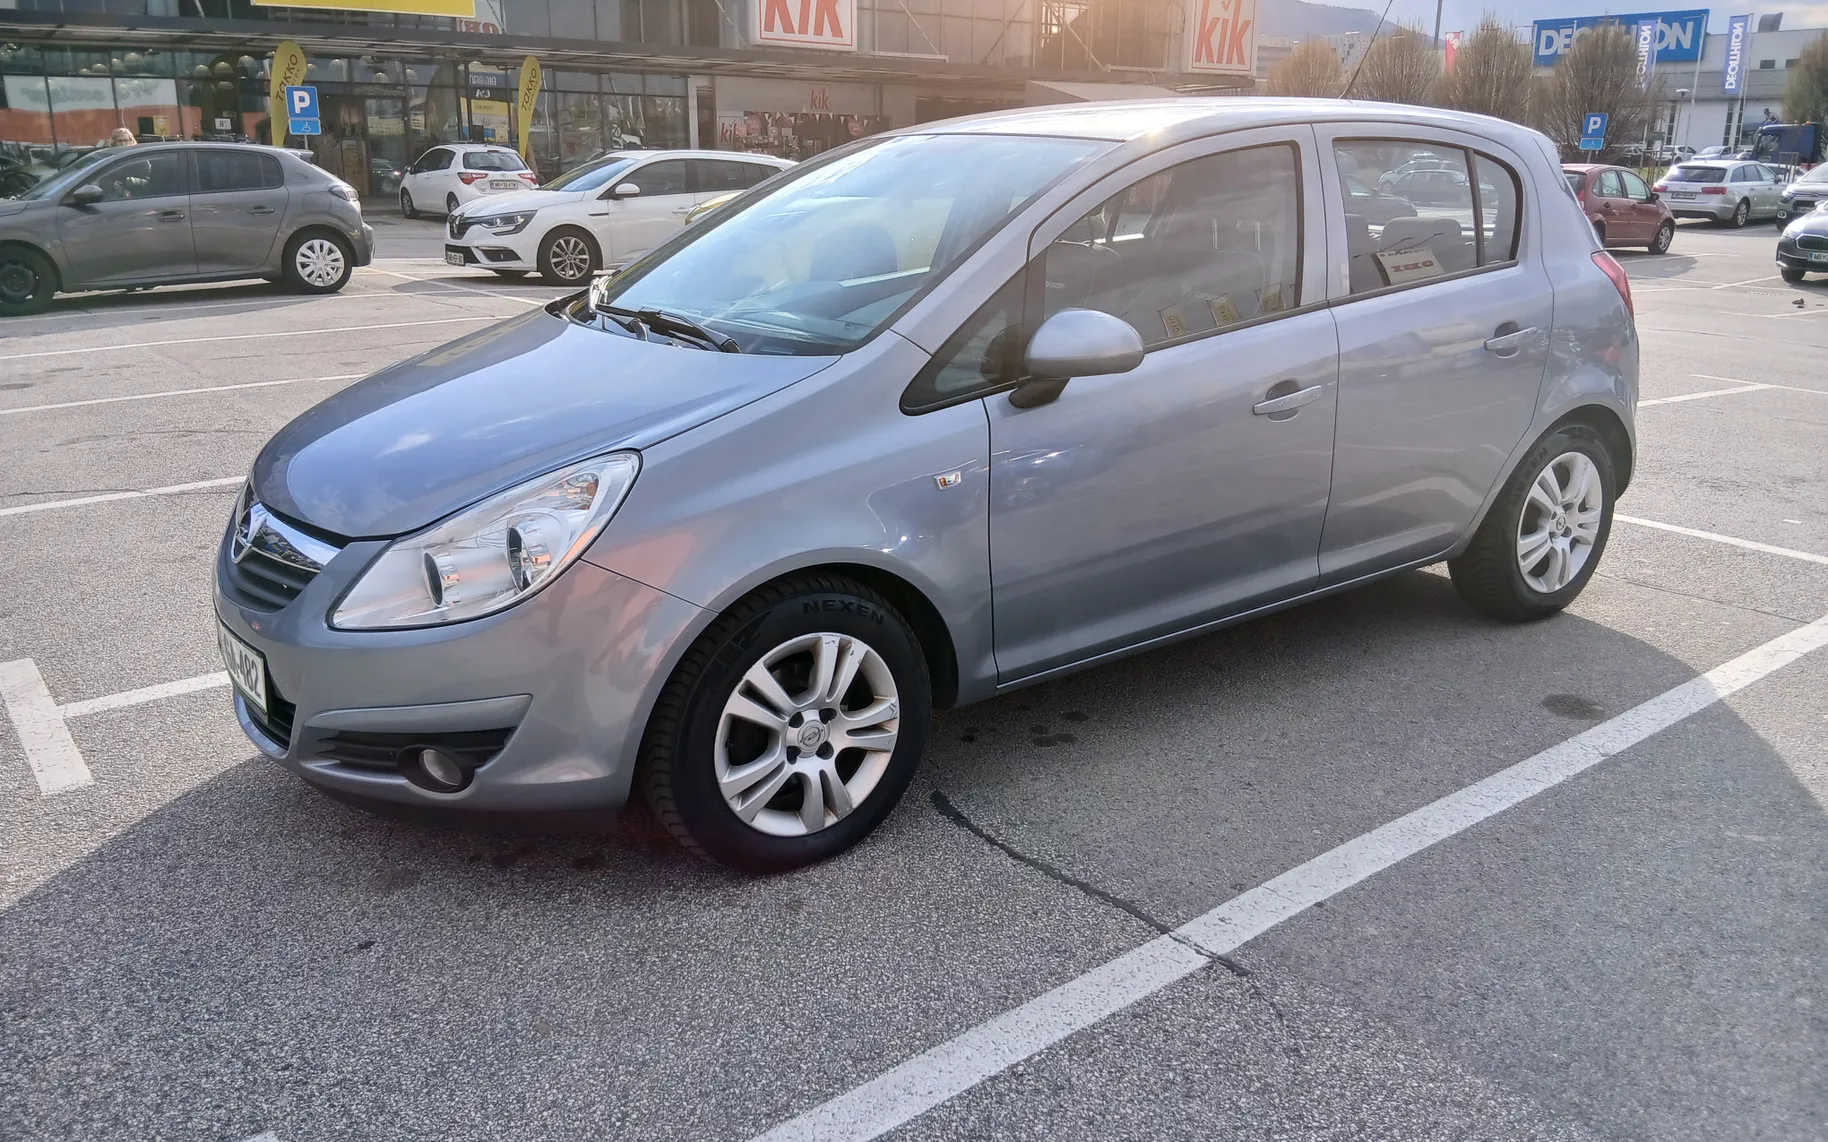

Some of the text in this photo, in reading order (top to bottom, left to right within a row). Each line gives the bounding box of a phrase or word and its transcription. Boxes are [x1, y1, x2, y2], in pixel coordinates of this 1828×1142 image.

[1539, 22, 1694, 56] DECON
[1635, 25, 1652, 89] CATHLON
[1725, 22, 1744, 89] DECATHLON
[293, 91, 310, 114] P
[1587, 116, 1602, 134] P
[803, 599, 885, 626] NEXEN
